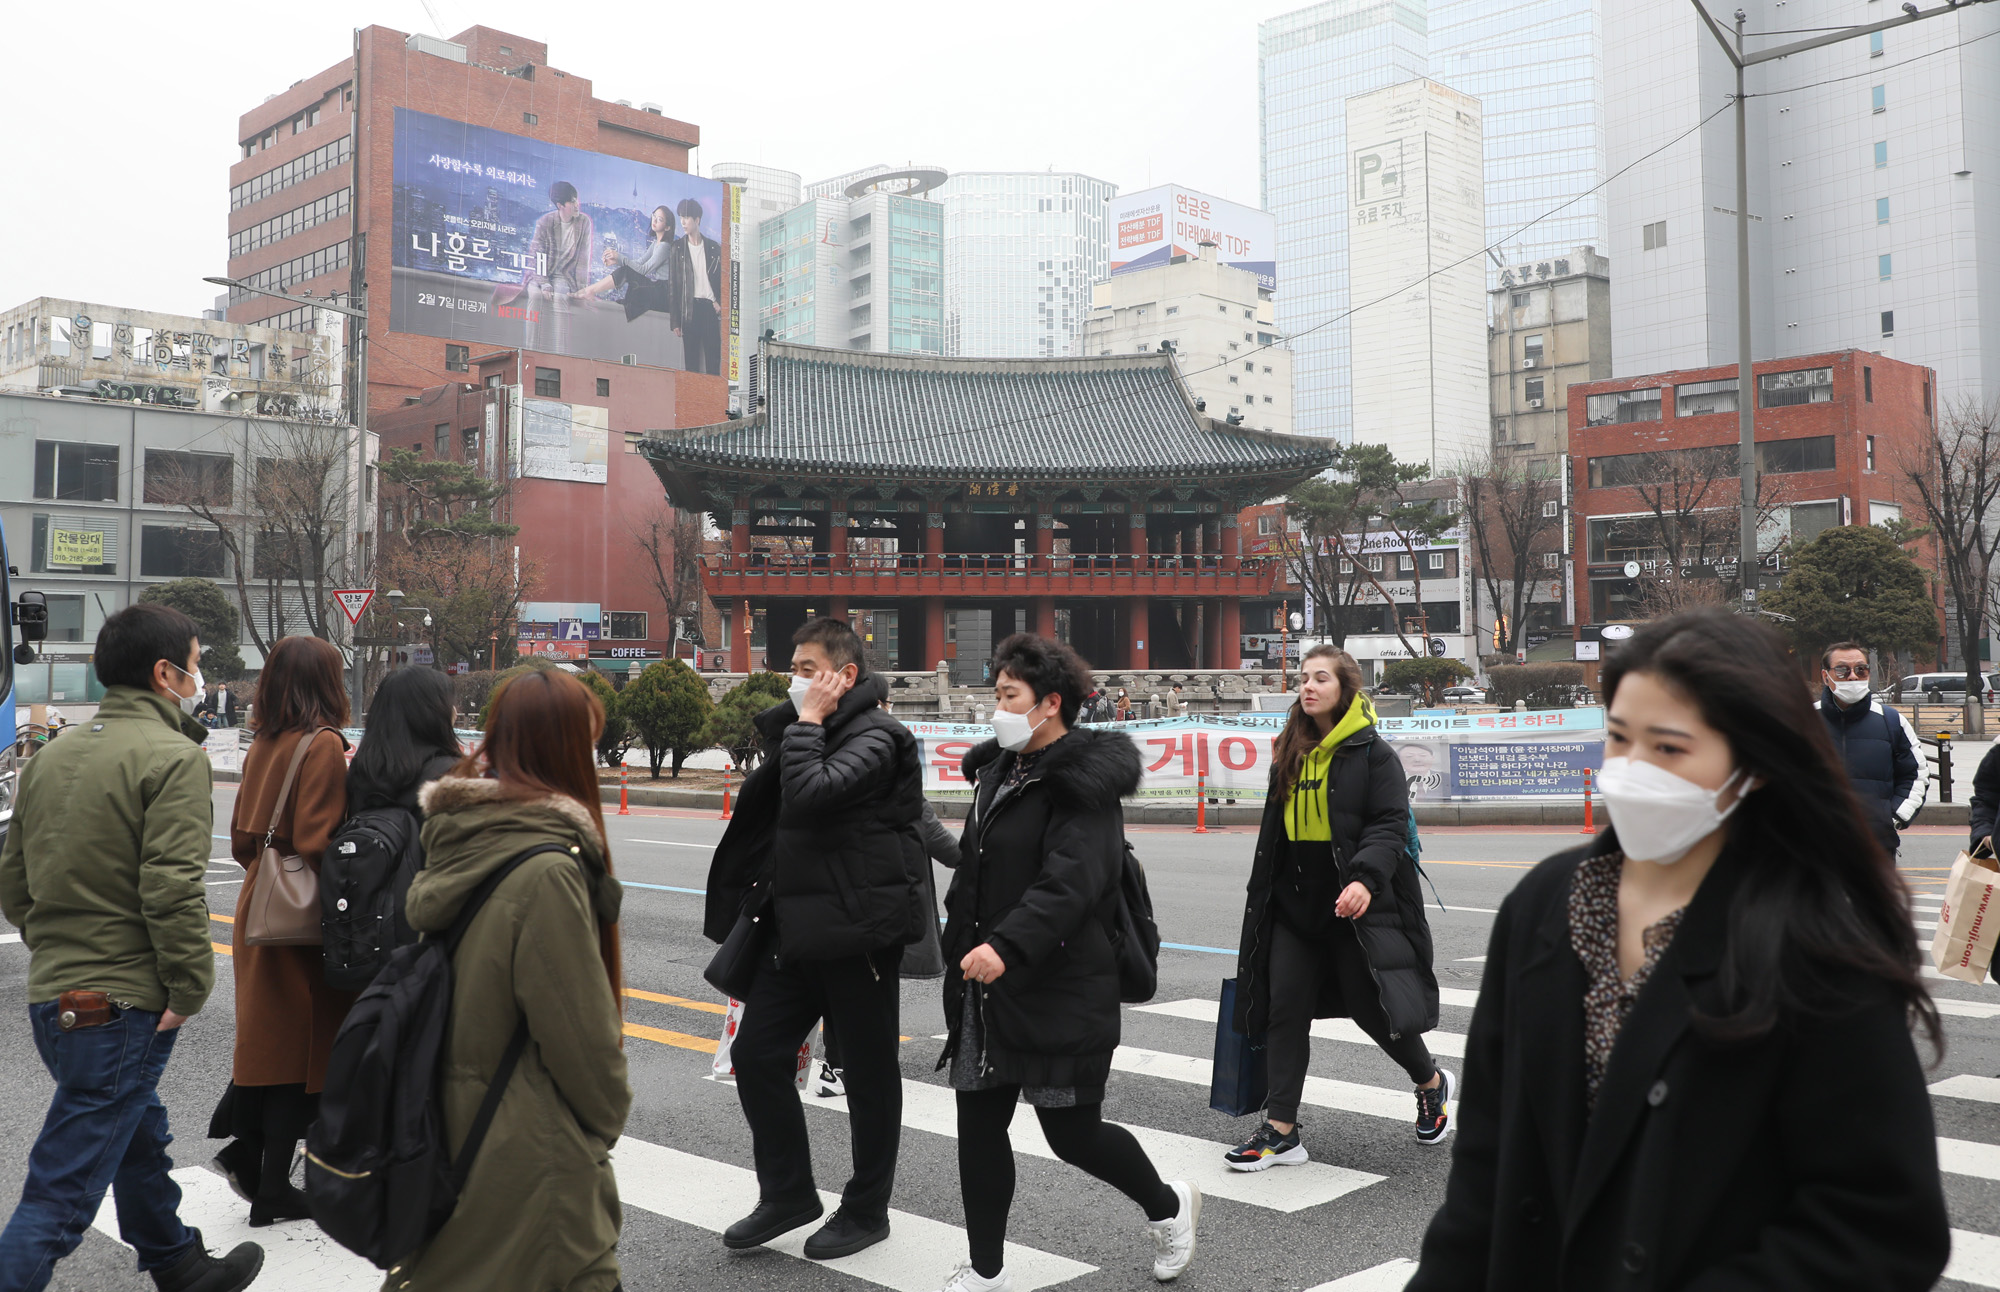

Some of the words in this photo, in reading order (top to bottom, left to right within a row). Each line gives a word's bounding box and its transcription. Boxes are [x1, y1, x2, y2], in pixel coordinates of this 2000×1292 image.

[429, 154, 483, 177] 사랑할수록
[485, 167, 537, 188] 외로워지는
[1176, 193, 1211, 221] 연금은
[470, 219, 497, 231] 오리지널
[497, 224, 517, 235] 시리즈
[1120, 220, 1145, 233] 자산배분
[1147, 216, 1161, 228] TDF
[1147, 229, 1161, 240] TDF
[1177, 221, 1222, 251] 미래에셋
[1225, 234, 1251, 257] TDF
[496, 250, 547, 277] 그대
[418, 292, 435, 306] 2월
[438, 295, 454, 309] 7일
[457, 298, 487, 314] 대공개
[498, 305, 540, 323] NETFLIX
[57, 532, 101, 545] 건물임대
[344, 594, 363, 603] 양보
[611, 647, 646, 658] COFFEE
[1410, 717, 1471, 730] 게이트
[1476, 715, 1518, 728] 특검
[1522, 713, 1565, 727] 하라
[1539, 745, 1585, 753] 서장에게)
[1458, 754, 1492, 762] 보냈다.
[1495, 754, 1516, 762] 대검
[1458, 762, 1499, 770] 연구관을
[1547, 761, 1568, 769] 나간
[1549, 769, 1581, 777] 윤우진
[1195, 789, 1242, 797] 민행동본부
[1960, 884, 1994, 967] www.muji.com
